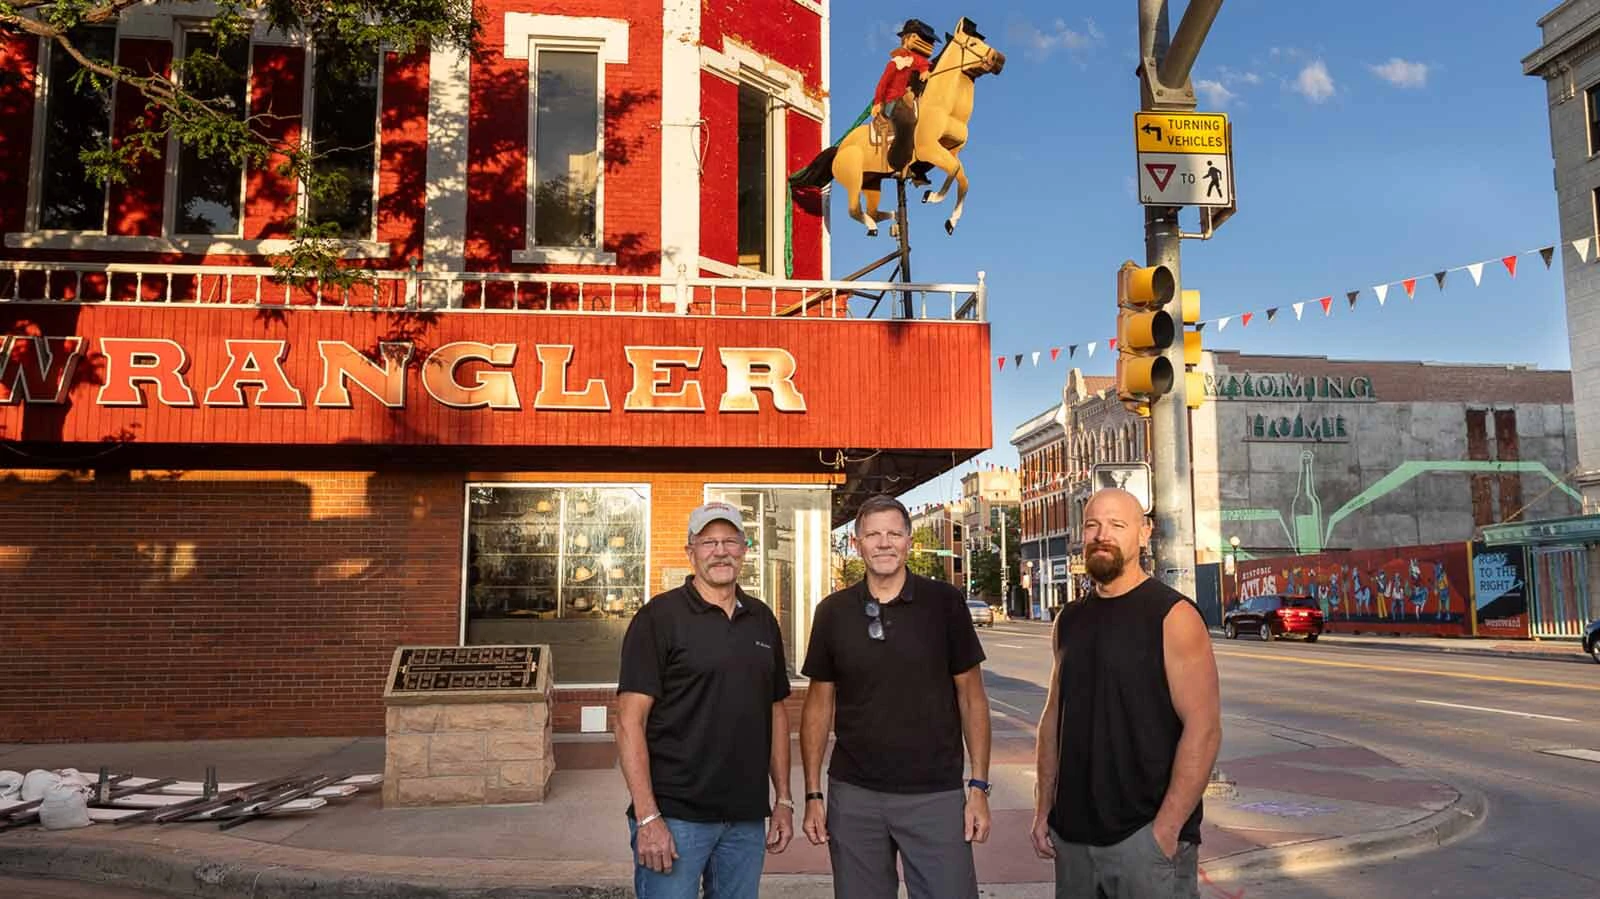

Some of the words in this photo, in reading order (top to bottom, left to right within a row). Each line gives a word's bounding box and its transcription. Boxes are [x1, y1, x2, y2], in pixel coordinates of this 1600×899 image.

[1167, 119, 1220, 131] TURNING
[1167, 136, 1223, 147] VEHICLES
[1180, 173, 1196, 185] TO
[0, 335, 807, 412] WRANGLER
[1203, 373, 1371, 398] WYOMING
[1247, 414, 1347, 438] HOME
[1479, 567, 1493, 578] TO
[1496, 566, 1517, 577] THE
[1240, 575, 1278, 603] ATLAS
[1480, 580, 1510, 591] RIGHT
